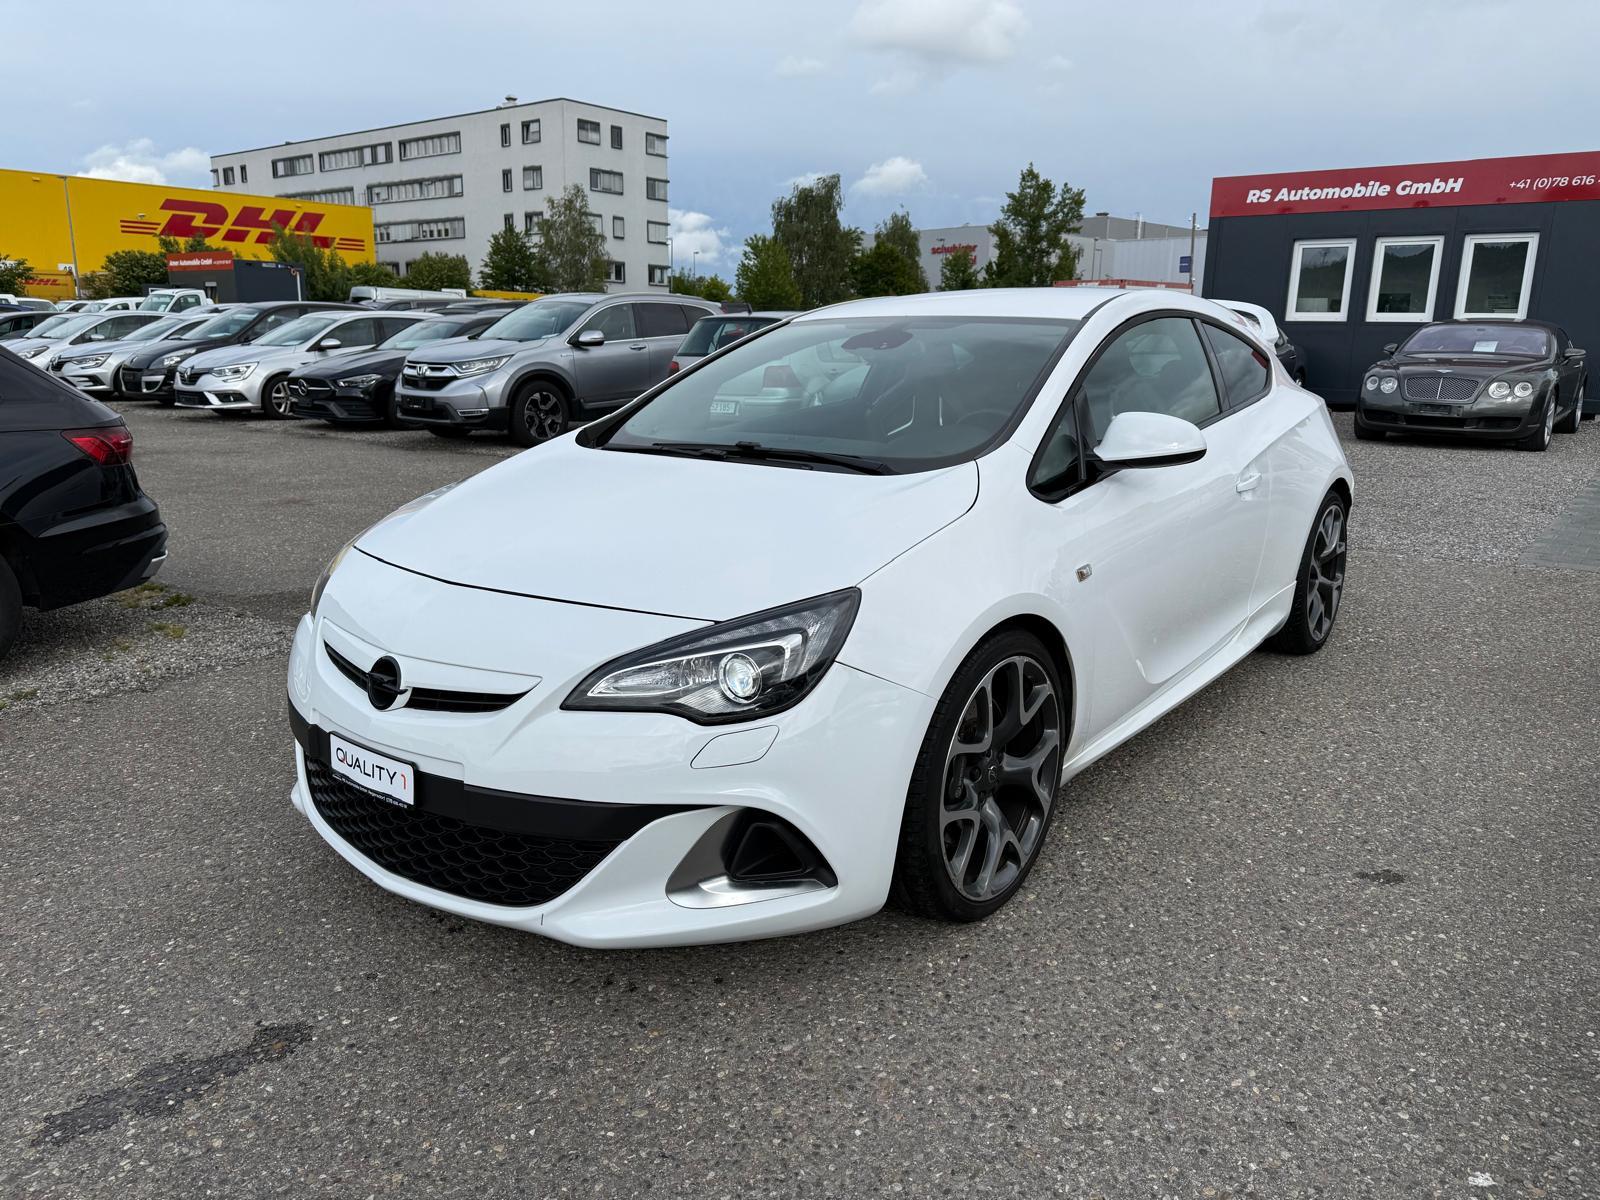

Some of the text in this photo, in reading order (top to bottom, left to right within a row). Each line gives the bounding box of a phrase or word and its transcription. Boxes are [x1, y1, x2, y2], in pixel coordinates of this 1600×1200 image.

[1246, 177, 1465, 204] RS Automobile GmbH
[1509, 179, 1531, 189] +41
[1533, 176, 1570, 191] (0)78
[1571, 174, 1596, 186] 616
[159, 198, 337, 249] DHL
[336, 747, 397, 785] QUALITY
[400, 773, 408, 790] 1
